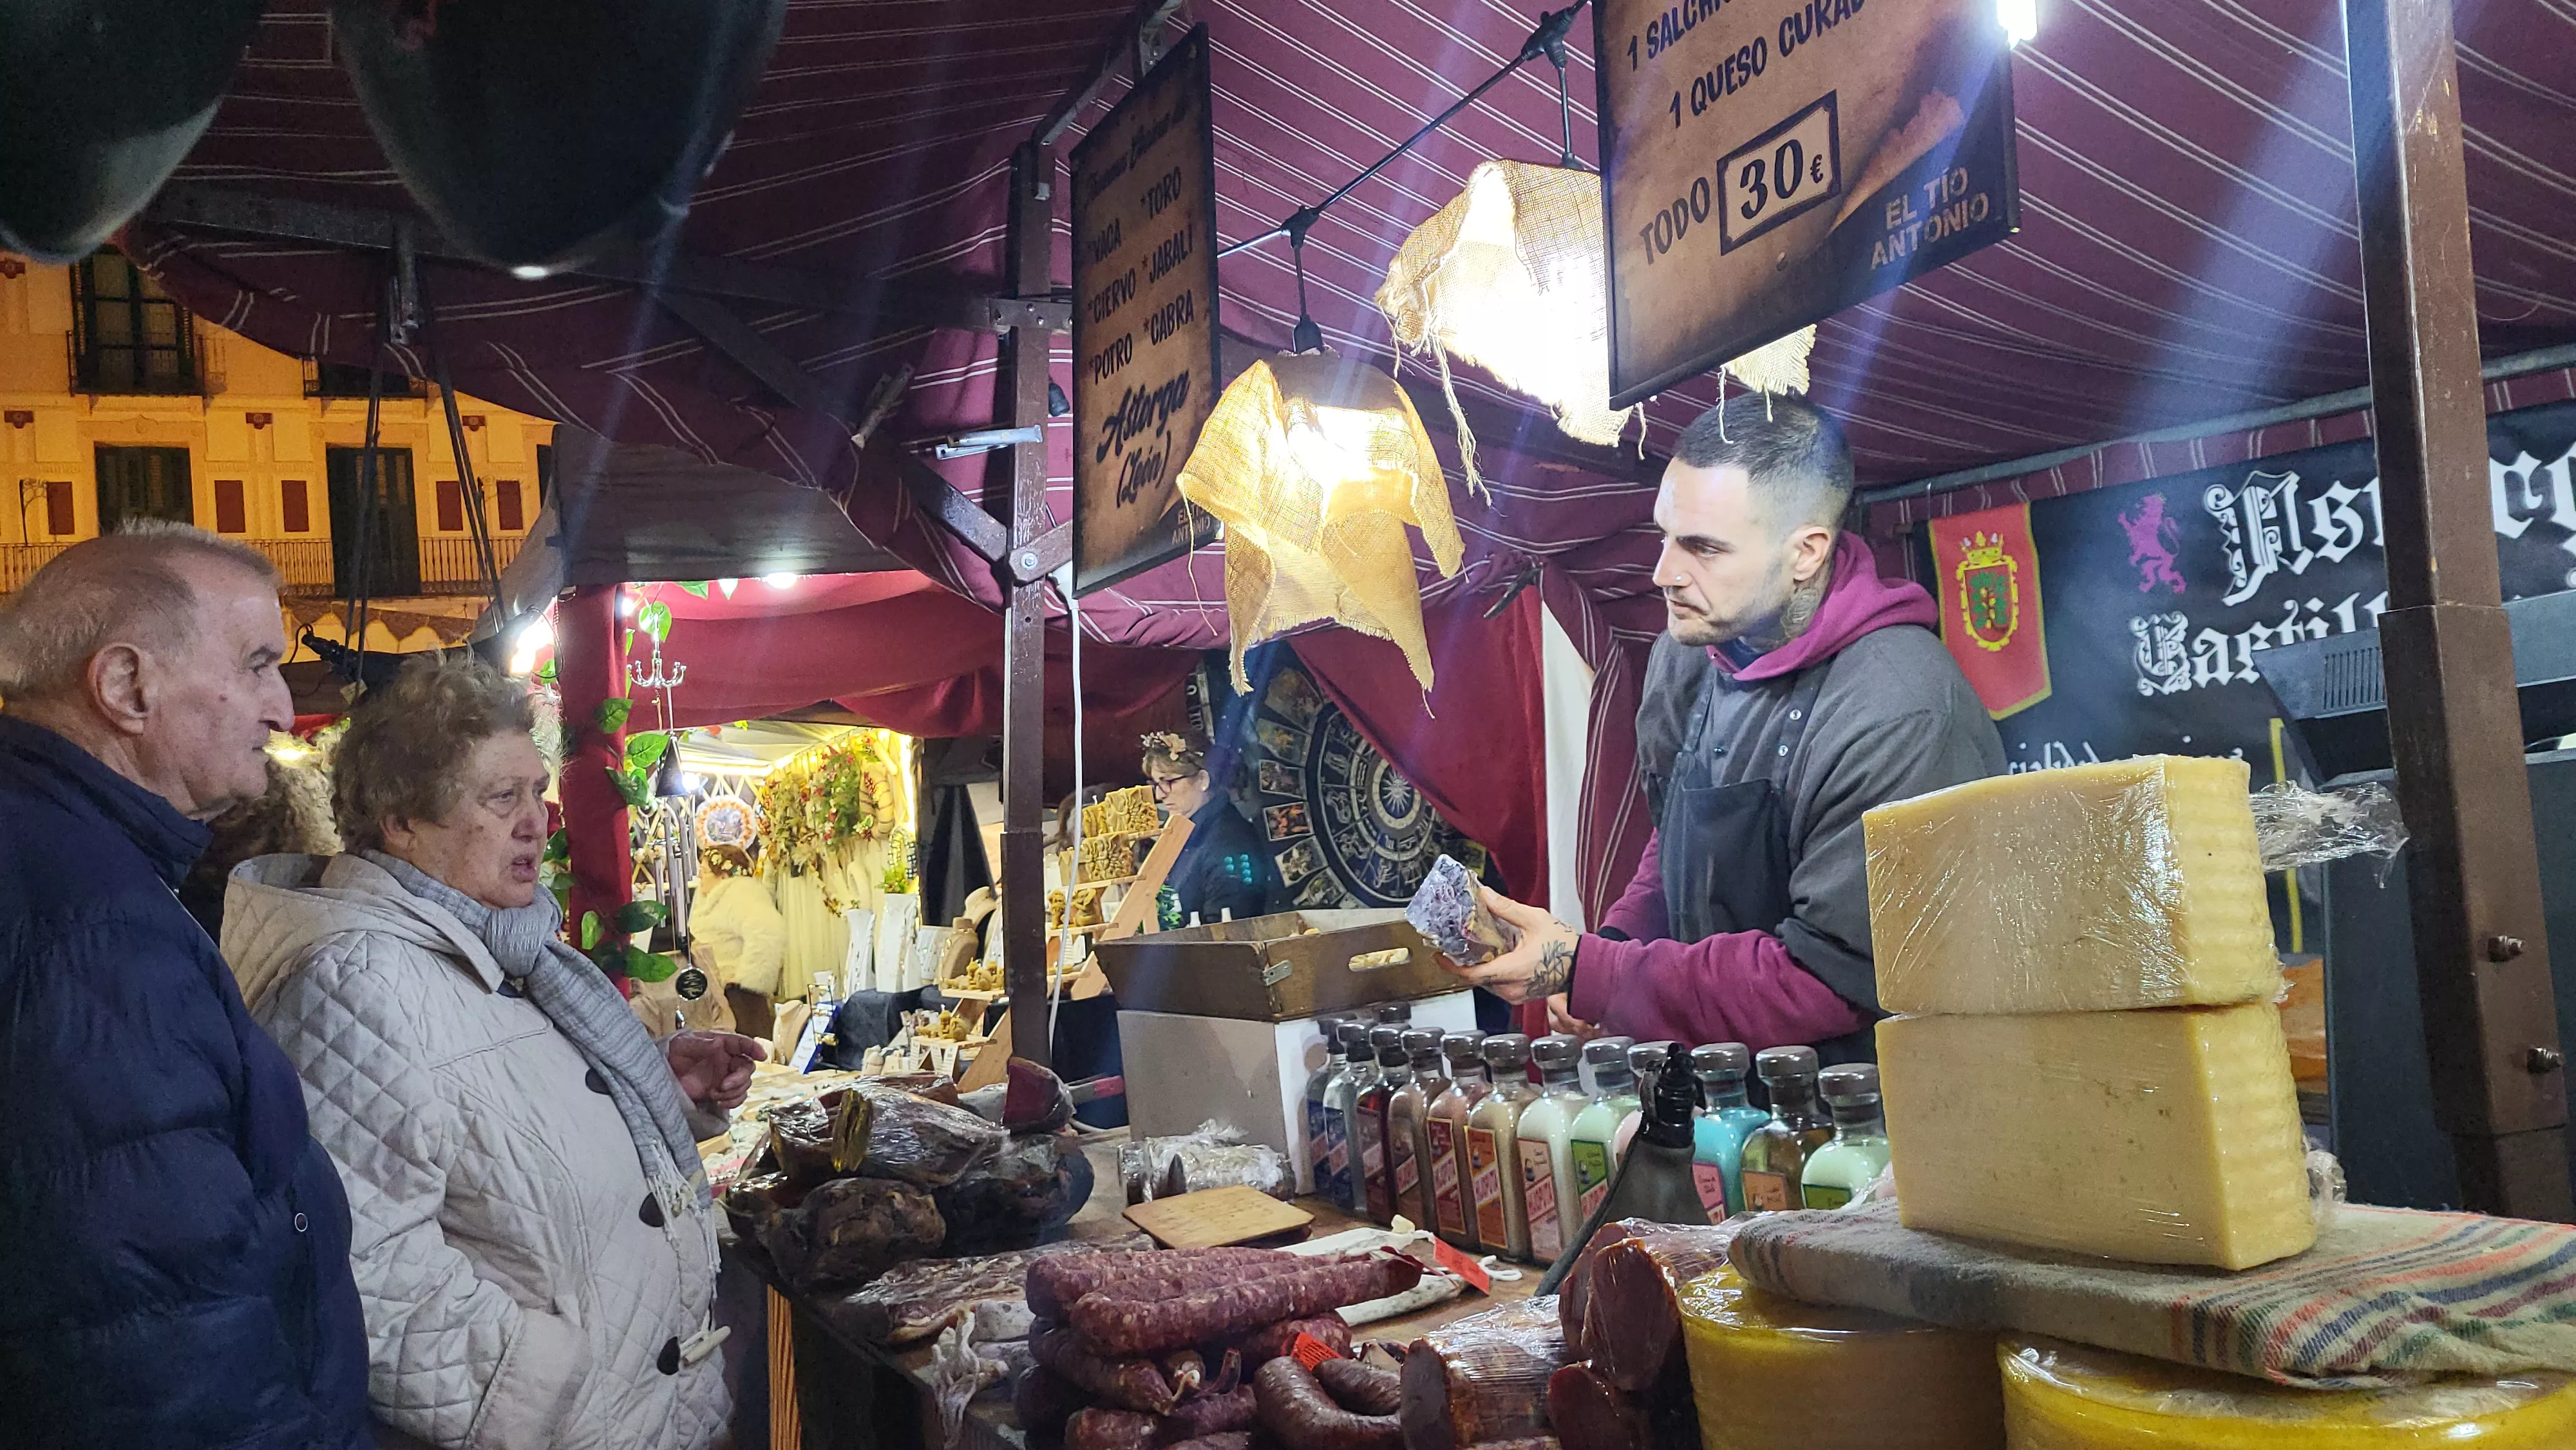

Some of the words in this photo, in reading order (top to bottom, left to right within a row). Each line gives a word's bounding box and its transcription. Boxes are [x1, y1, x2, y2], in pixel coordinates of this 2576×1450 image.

[1627, 35, 1638, 72] 1
[1669, 91, 1681, 129] 1
[1691, 35, 1768, 117] QUESO
[1146, 165, 1182, 220] TORO
[1639, 176, 1711, 265] TODO
[1870, 192, 1990, 270] ANTONIO
[1885, 194, 1918, 231] EL
[1923, 167, 1970, 209] TÍO
[1094, 267, 1136, 324] CIERVO
[1094, 332, 1133, 386] POTRO
[1150, 288, 1195, 346] CABRA
[1096, 370, 1191, 464] Astorga
